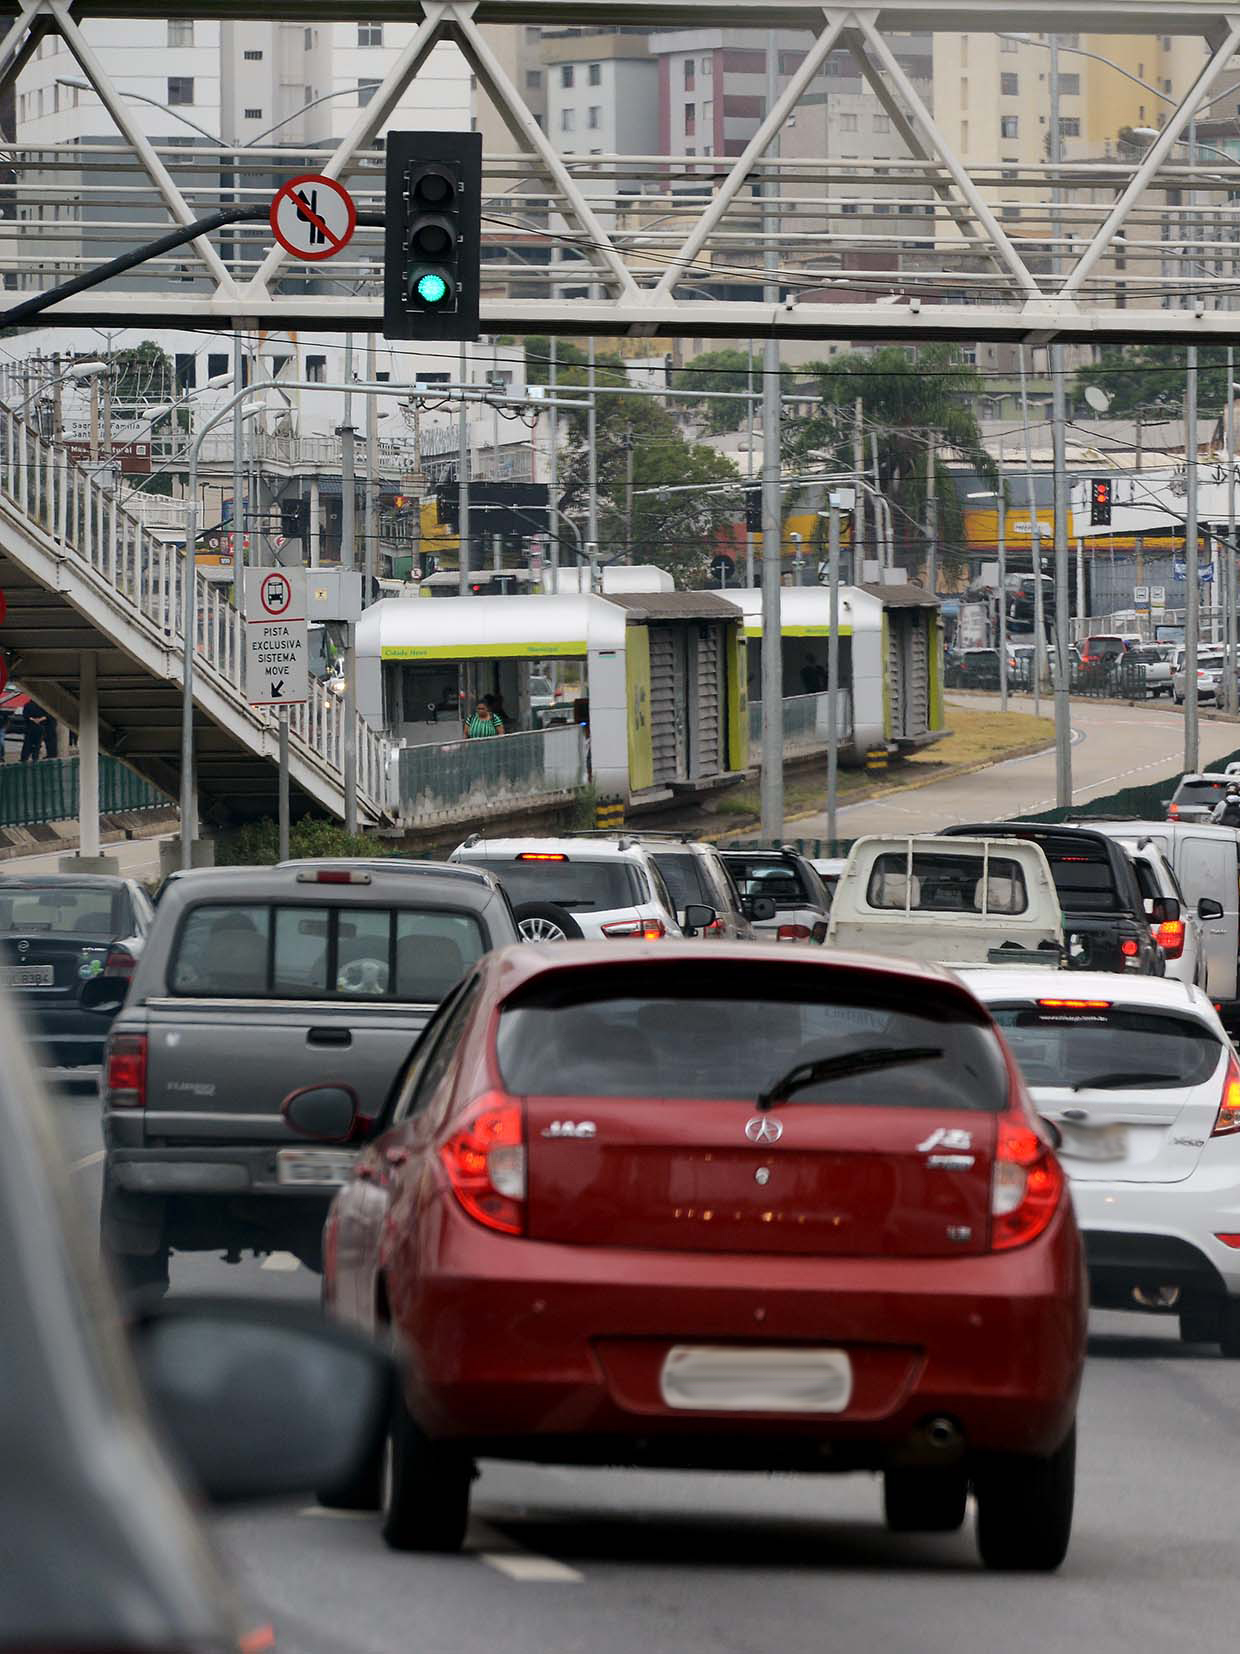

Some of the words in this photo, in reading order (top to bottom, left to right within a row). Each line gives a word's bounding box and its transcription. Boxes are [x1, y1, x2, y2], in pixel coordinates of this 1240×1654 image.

[264, 627, 290, 636] PISTA
[252, 640, 302, 650] EXCLUSIVA
[258, 653, 297, 663] SISTEMA
[265, 666, 290, 675] MOVE
